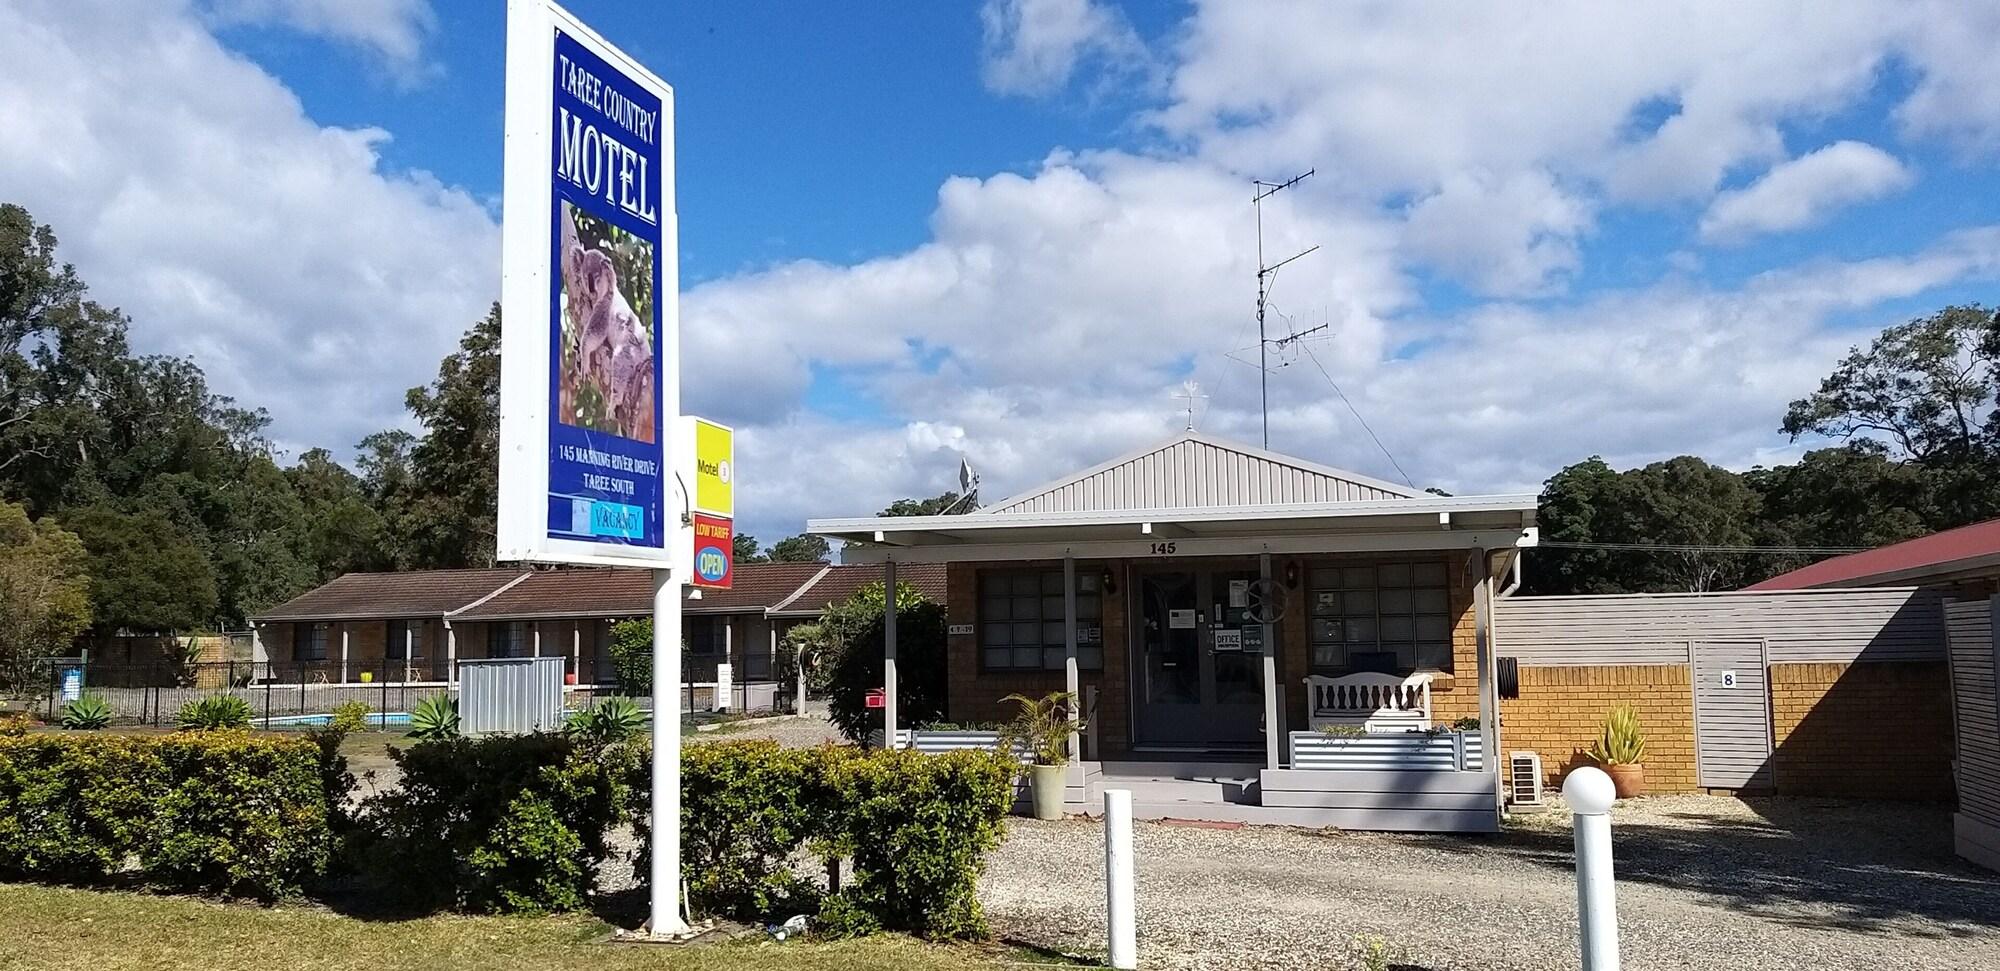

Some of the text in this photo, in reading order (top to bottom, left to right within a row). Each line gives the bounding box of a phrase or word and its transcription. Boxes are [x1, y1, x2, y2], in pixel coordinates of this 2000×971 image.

[559, 53, 657, 145] TAREE COUNTRY
[557, 106, 657, 226] MOTEL
[560, 444, 656, 476] 145 MANNING RIVER DRIVE
[698, 459, 719, 477] Motel
[583, 472, 635, 496] TAREE SOUTH
[595, 509, 640, 531] VACANCY
[696, 523, 730, 540] LOW TARIFF
[1151, 542, 1176, 554] 145
[700, 552, 724, 576] OPEN
[1216, 634, 1240, 643] OFFICE
[1724, 674, 1733, 686] 8
